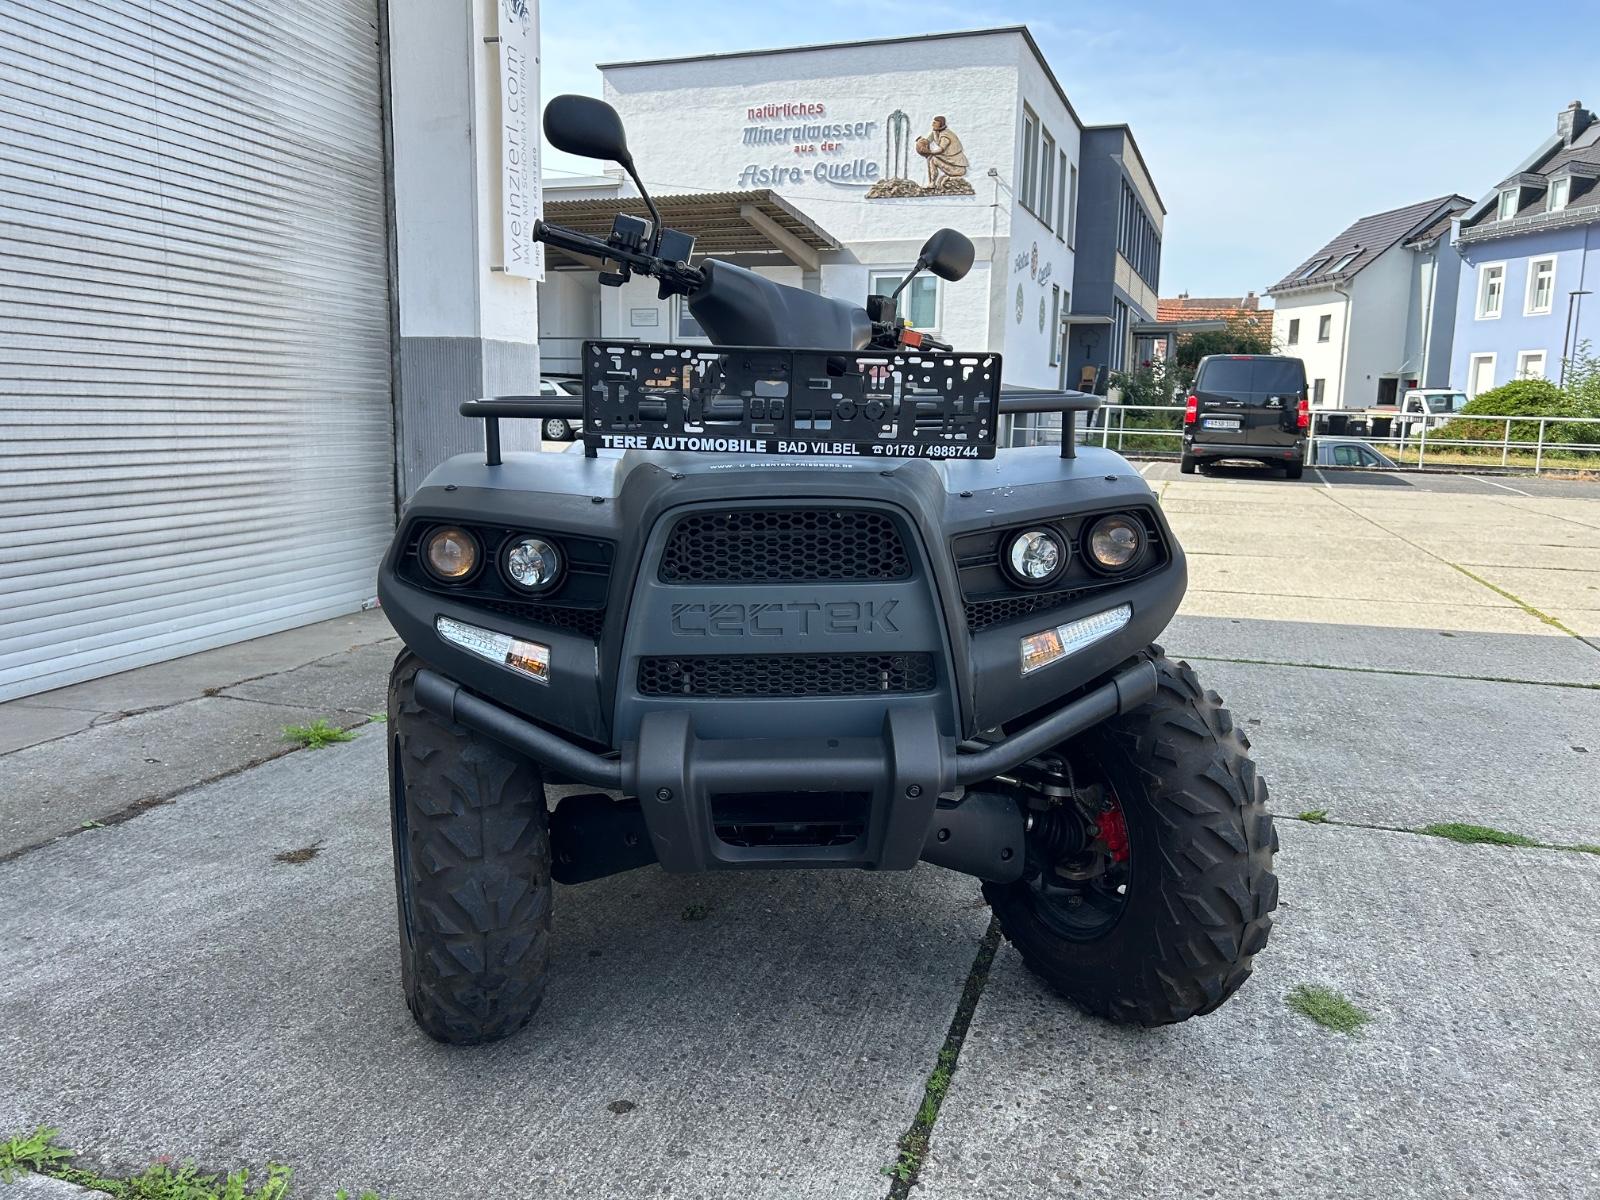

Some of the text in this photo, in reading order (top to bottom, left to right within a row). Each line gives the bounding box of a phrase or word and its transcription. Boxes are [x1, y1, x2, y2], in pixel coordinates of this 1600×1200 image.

[747, 102, 825, 121] natürliches
[742, 120, 877, 144] Mineralwasser
[793, 140, 841, 153] aus der
[738, 159, 879, 187] Astra-Quelle
[601, 435, 648, 449] TERE
[652, 437, 767, 453] AUTOMOBILE
[778, 441, 808, 454] BAD
[812, 443, 860, 455] VILBEL
[885, 444, 915, 456] 0178
[925, 445, 979, 458] 4988744
